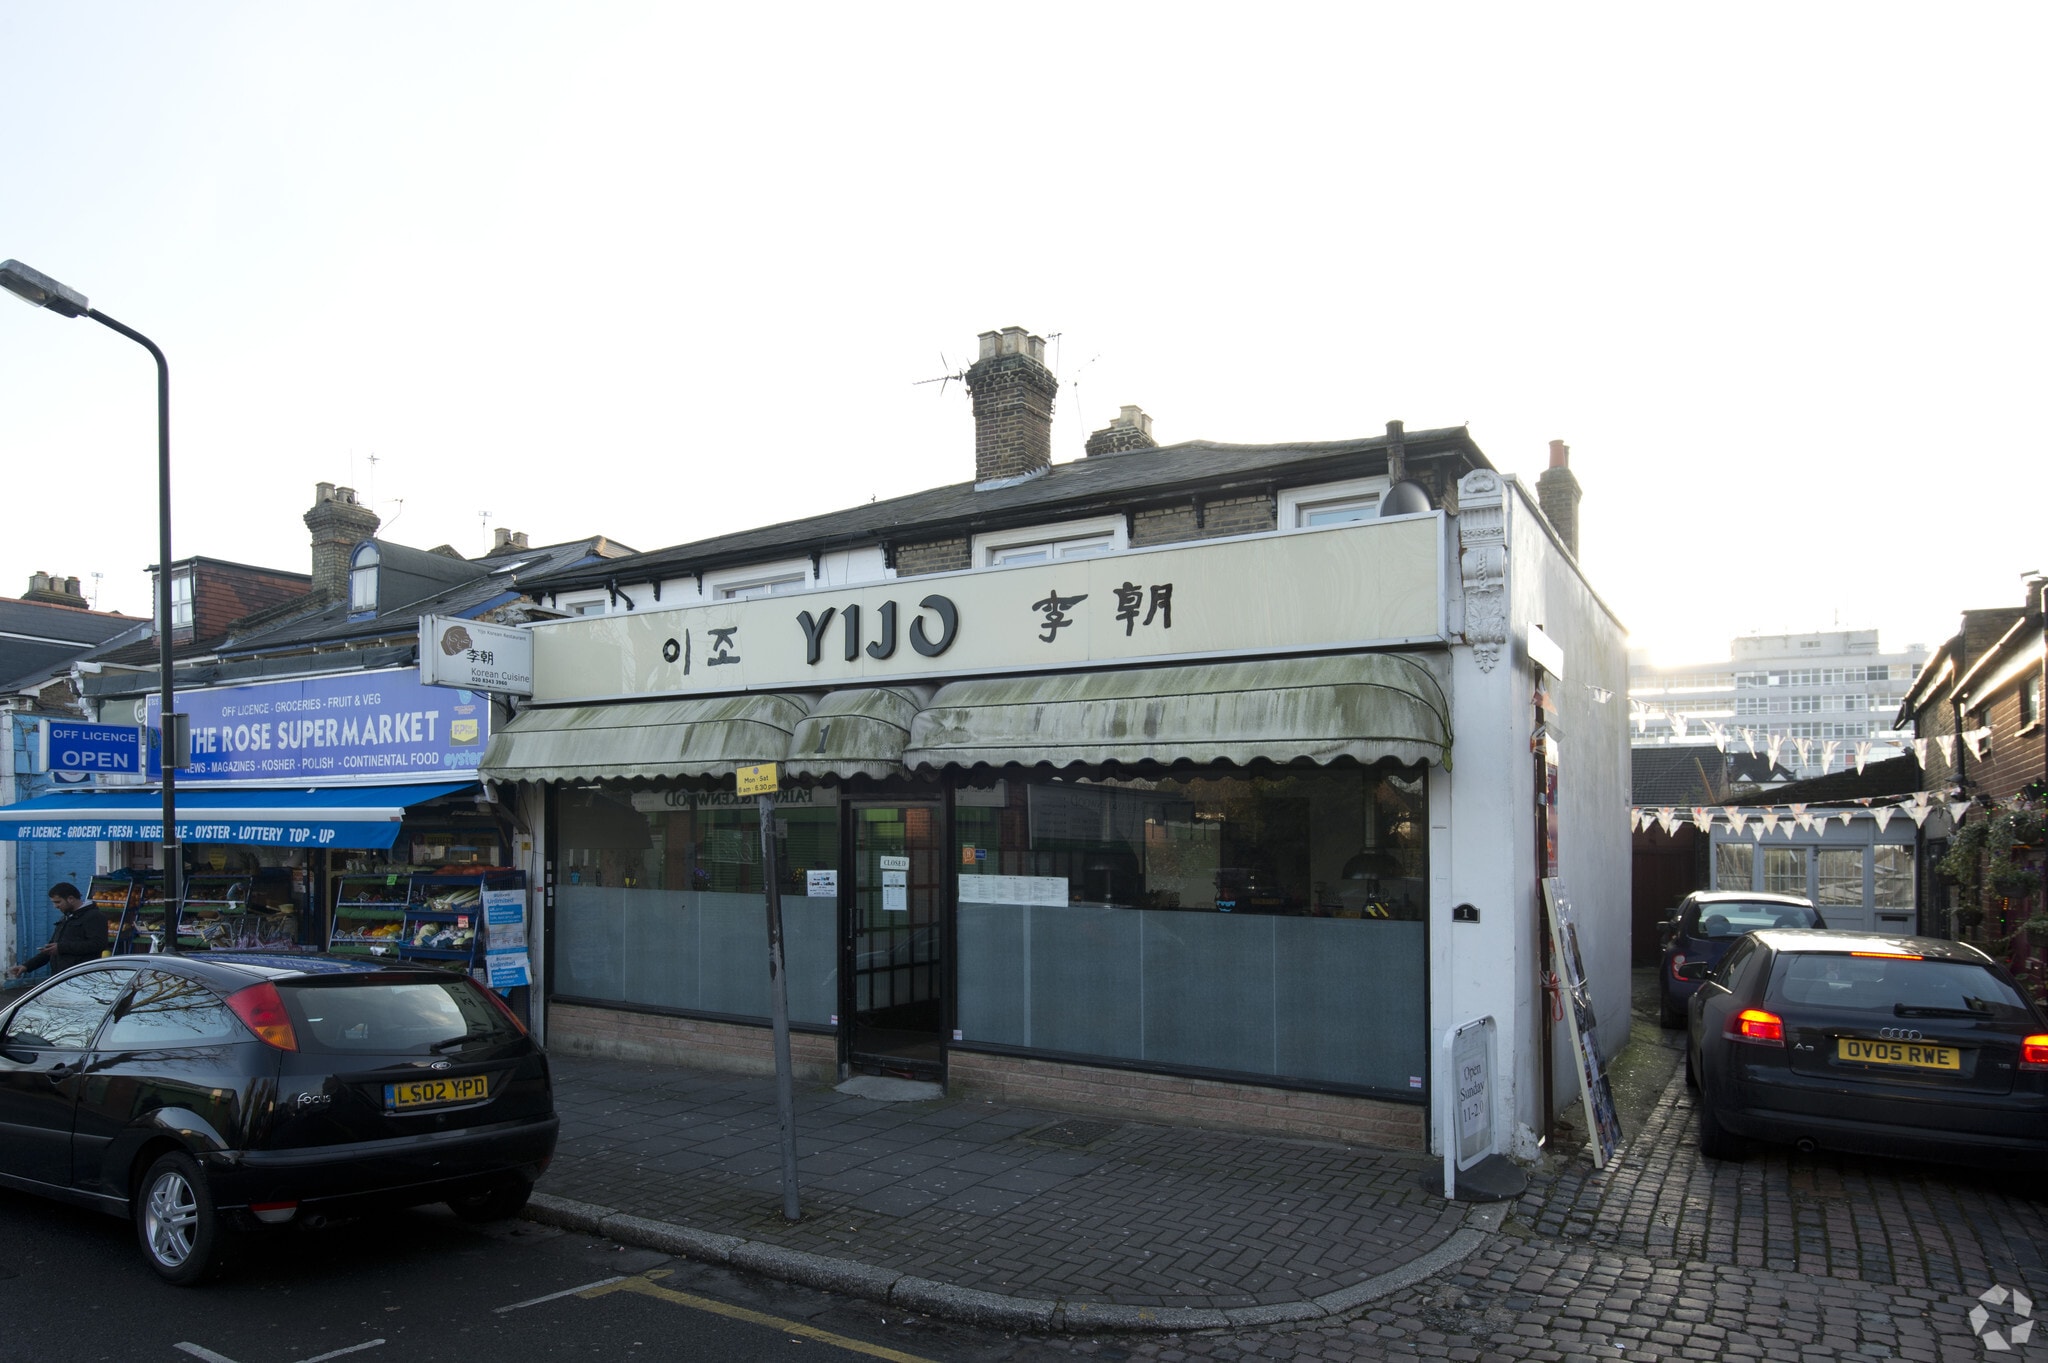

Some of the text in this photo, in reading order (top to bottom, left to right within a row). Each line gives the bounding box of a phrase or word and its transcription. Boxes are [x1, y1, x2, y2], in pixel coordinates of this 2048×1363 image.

[1031, 581, 1173, 644] 李朝
[503, 632, 527, 641] Restaurant
[796, 594, 959, 666] YIJO
[466, 648, 494, 666] 李朝
[662, 626, 741, 676] 이조
[471, 667, 530, 683] Korean Cuisine
[222, 706, 236, 717] OFF
[238, 703, 269, 716] LICENCE
[275, 699, 321, 713] GROCERIES
[328, 695, 352, 708] FRUIT
[354, 695, 361, 707] &
[362, 693, 381, 705] VEG
[53, 729, 136, 743] OFF LICENCE
[190, 727, 217, 754] THE
[222, 723, 271, 753] ROSE
[278, 710, 439, 750] SUPERMARKET
[814, 724, 830, 754] 1
[62, 750, 128, 768] OPEN
[211, 760, 256, 773] MAGAZINES
[262, 759, 296, 771] KOSHER
[302, 757, 334, 769] POLISH
[343, 753, 408, 768] CONTINENTAL
[410, 752, 439, 766] FOOD
[444, 749, 485, 770] oyster
[768, 783, 777, 792] pm
[18, 826, 31, 838] OFF
[32, 826, 61, 838] LICENCE
[67, 826, 102, 838] GROCERY
[108, 825, 133, 838] FRESH
[195, 825, 231, 839] OYSTER
[238, 826, 283, 842] LOTTERY
[289, 828, 310, 843] TOP
[318, 829, 335, 844] UP
[883, 859, 907, 867] CLOSED
[1462, 908, 1470, 919] 1
[1793, 1042, 1815, 1051] A3
[1847, 1041, 1951, 1066] OV05 RWE
[1463, 1064, 1482, 1082] Open
[397, 1077, 486, 1105] LS02 YPD
[1460, 1081, 1485, 1103] Sunday
